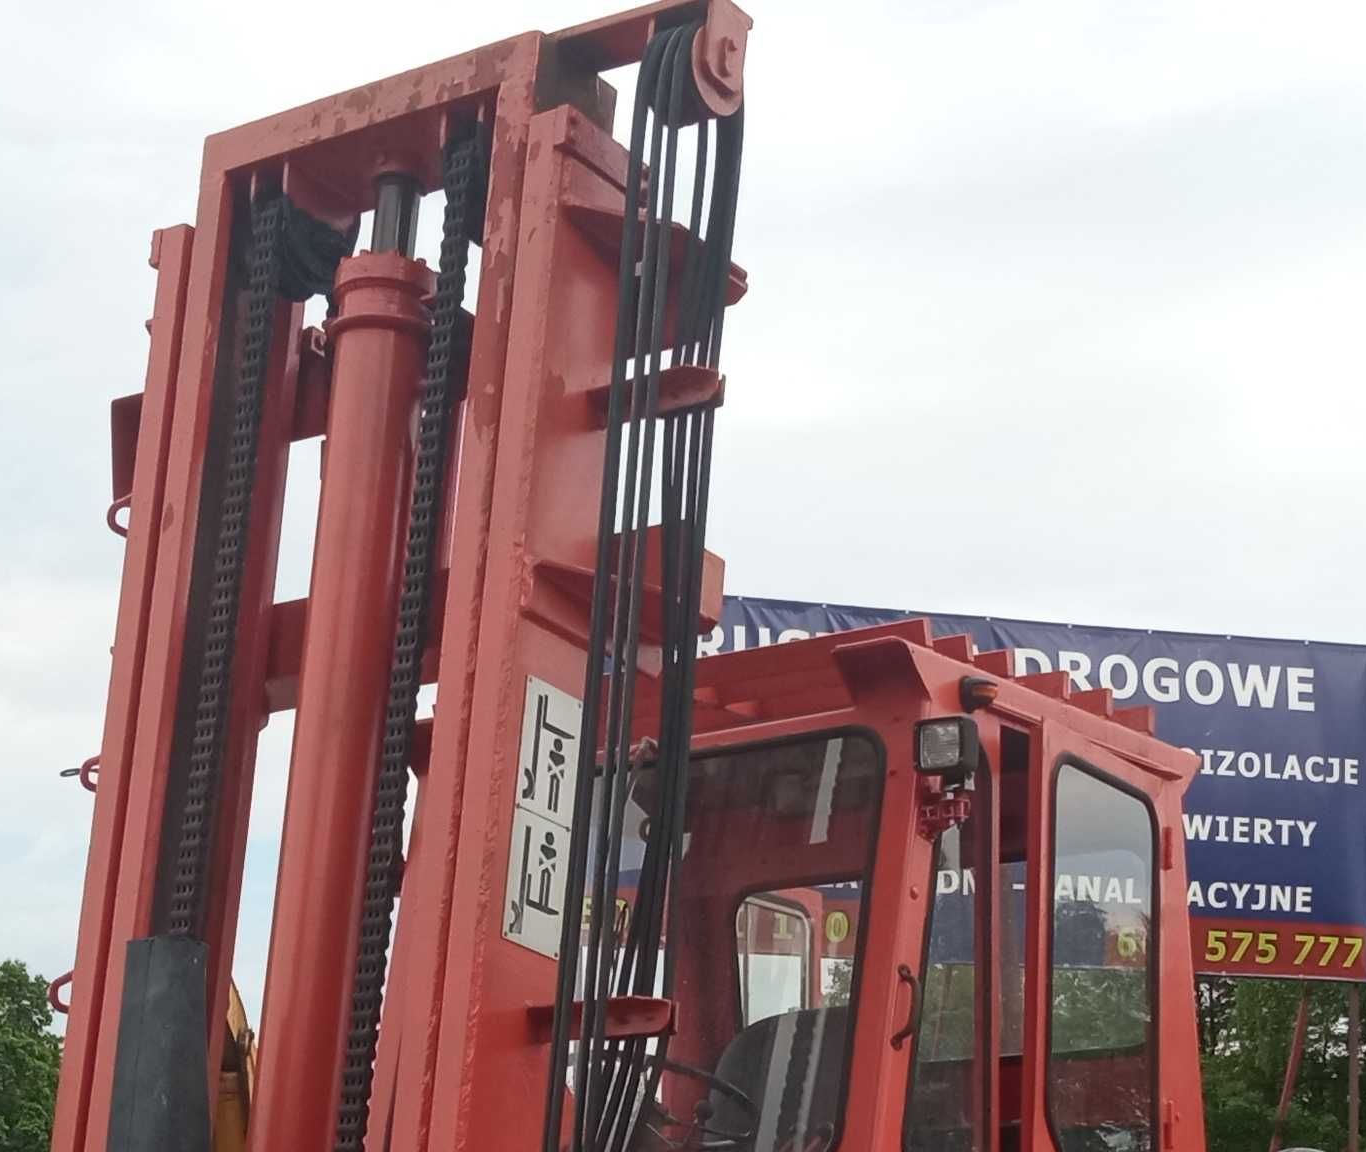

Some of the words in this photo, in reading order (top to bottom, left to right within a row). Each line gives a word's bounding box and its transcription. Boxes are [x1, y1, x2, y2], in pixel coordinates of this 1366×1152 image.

[1014, 647, 1316, 712] DROGOWE
[1180, 747, 1359, 785] IZOLACJE
[1182, 813, 1317, 847] WIERTY
[1204, 930, 1278, 964] 575
[1293, 934, 1363, 968] 777
